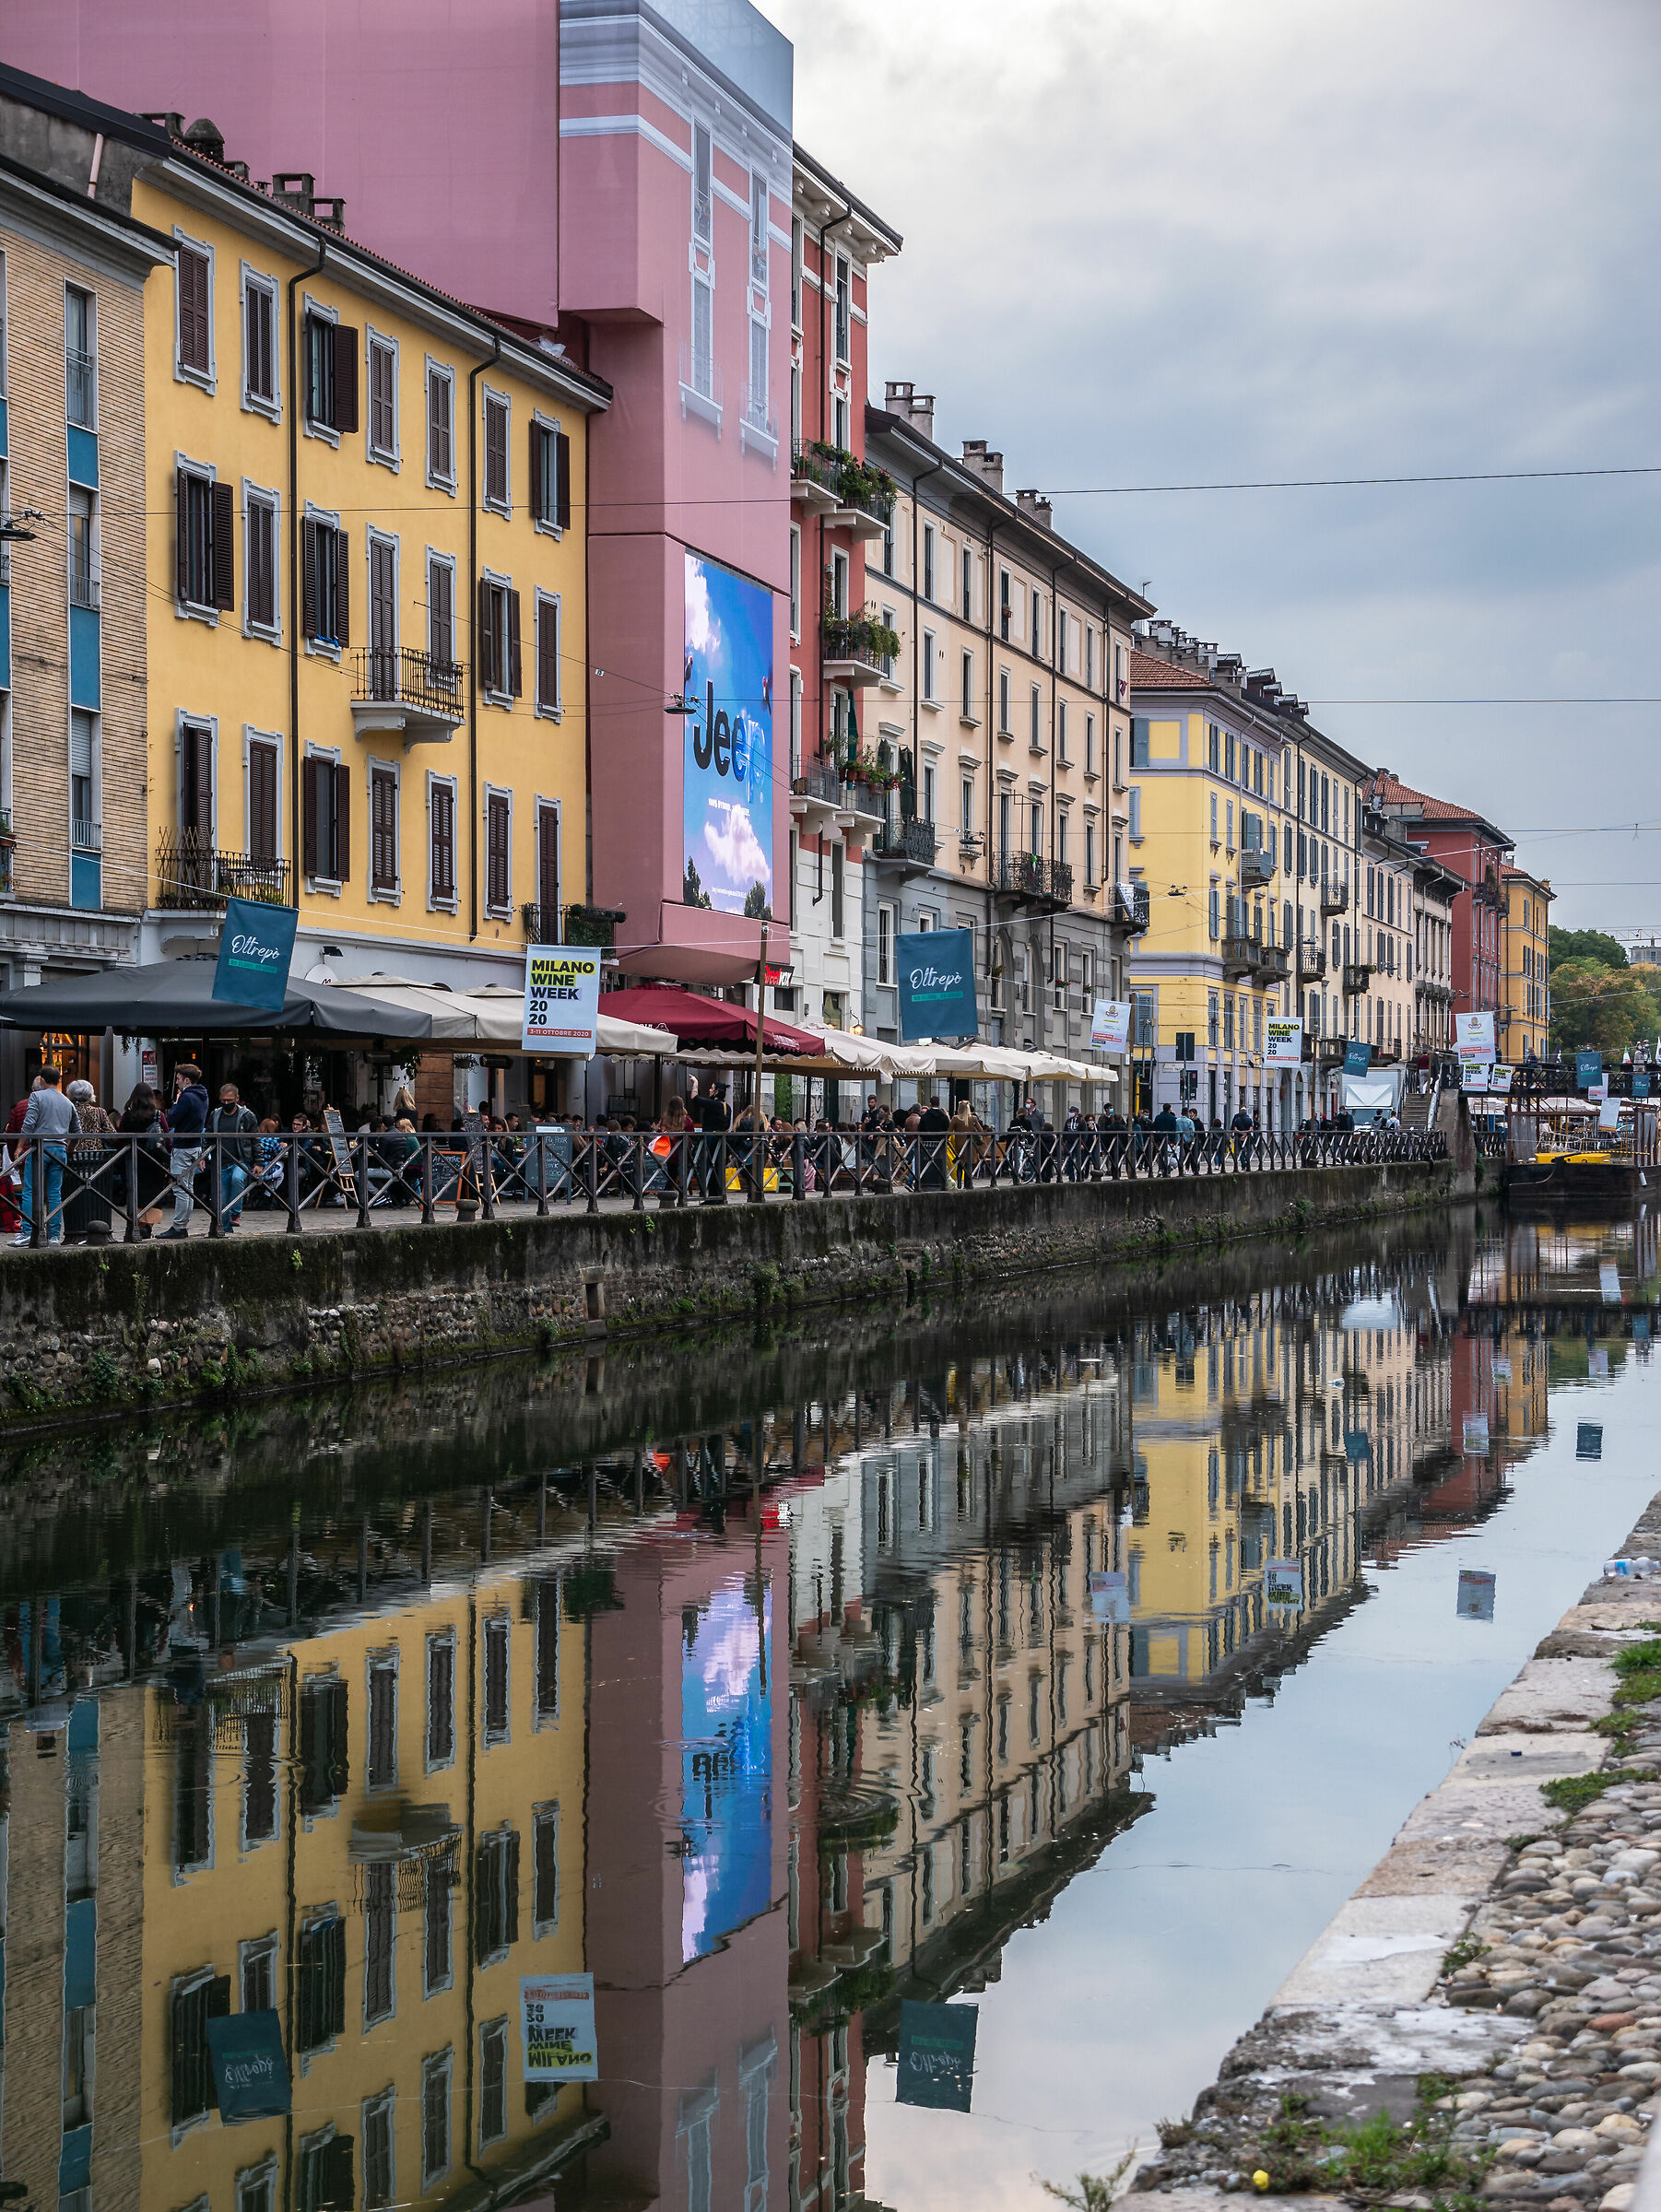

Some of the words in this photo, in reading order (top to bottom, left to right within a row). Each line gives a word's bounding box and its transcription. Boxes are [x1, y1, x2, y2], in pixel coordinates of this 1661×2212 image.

[693, 678, 766, 803] Jeep
[231, 935, 280, 963] Oltrepò
[532, 959, 595, 974] MILANO
[531, 973, 574, 986] WINE
[910, 967, 962, 992] Oltrepò
[530, 986, 580, 1000] WEEK
[530, 1000, 548, 1012] 20
[529, 1014, 548, 1025] 20
